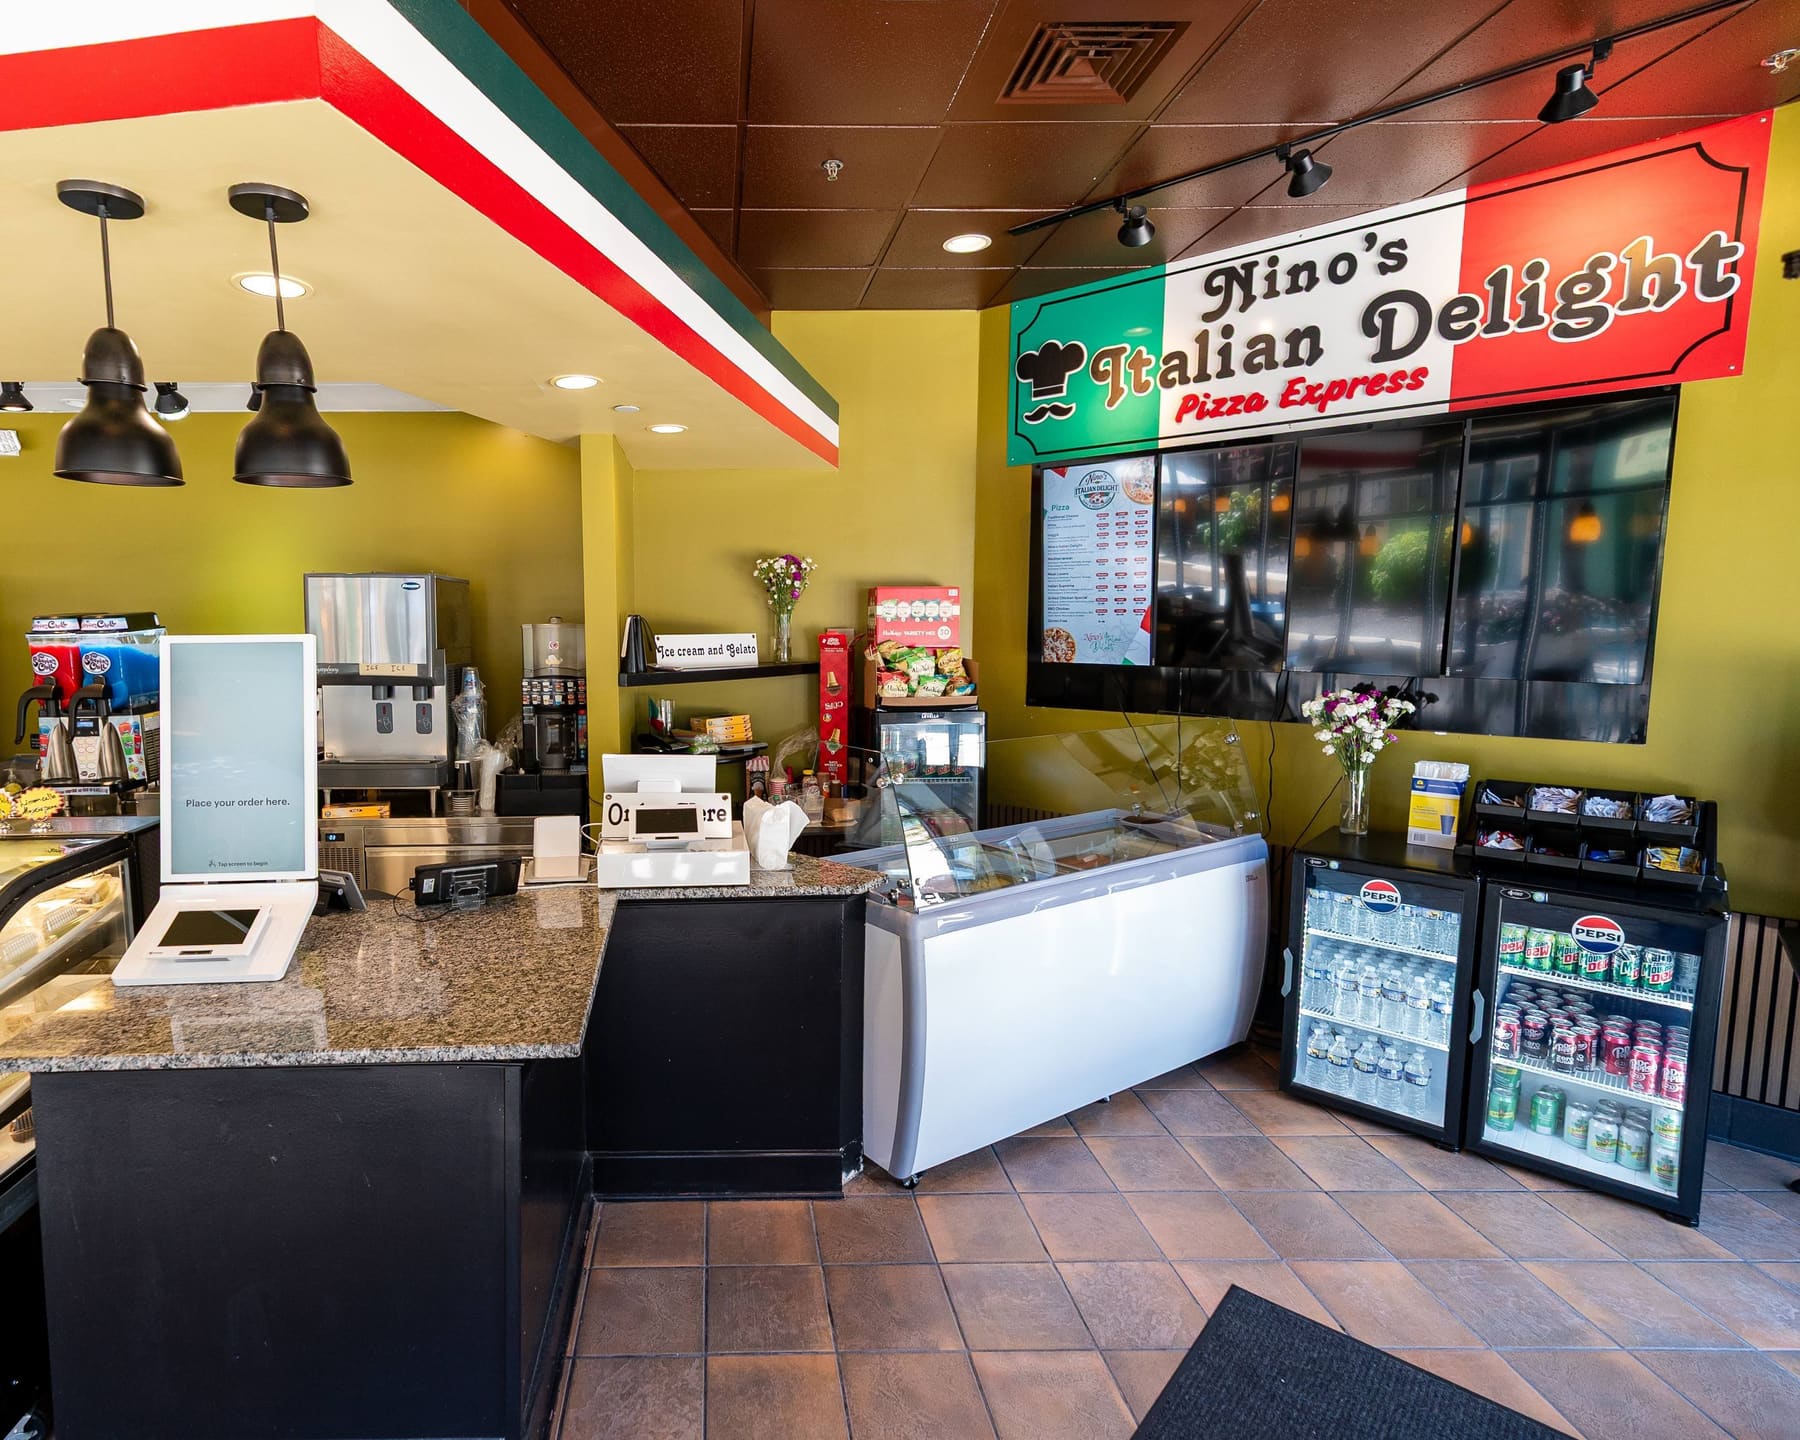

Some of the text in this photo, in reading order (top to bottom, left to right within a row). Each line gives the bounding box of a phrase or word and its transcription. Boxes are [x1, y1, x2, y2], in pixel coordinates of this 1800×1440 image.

[1201, 232, 1408, 323] Nino's
[1090, 231, 1744, 409] Italian Delight
[1175, 366, 1429, 423] Pizza Express
[1075, 484, 1118, 495] ITALIAN DELIGHT
[1051, 504, 1070, 512] Pizza
[657, 643, 756, 659] Ice cream and Gelato
[186, 797, 290, 808] Place your order here.
[1362, 890, 1398, 903] PEPSI
[1575, 927, 1621, 942] PEPSI
